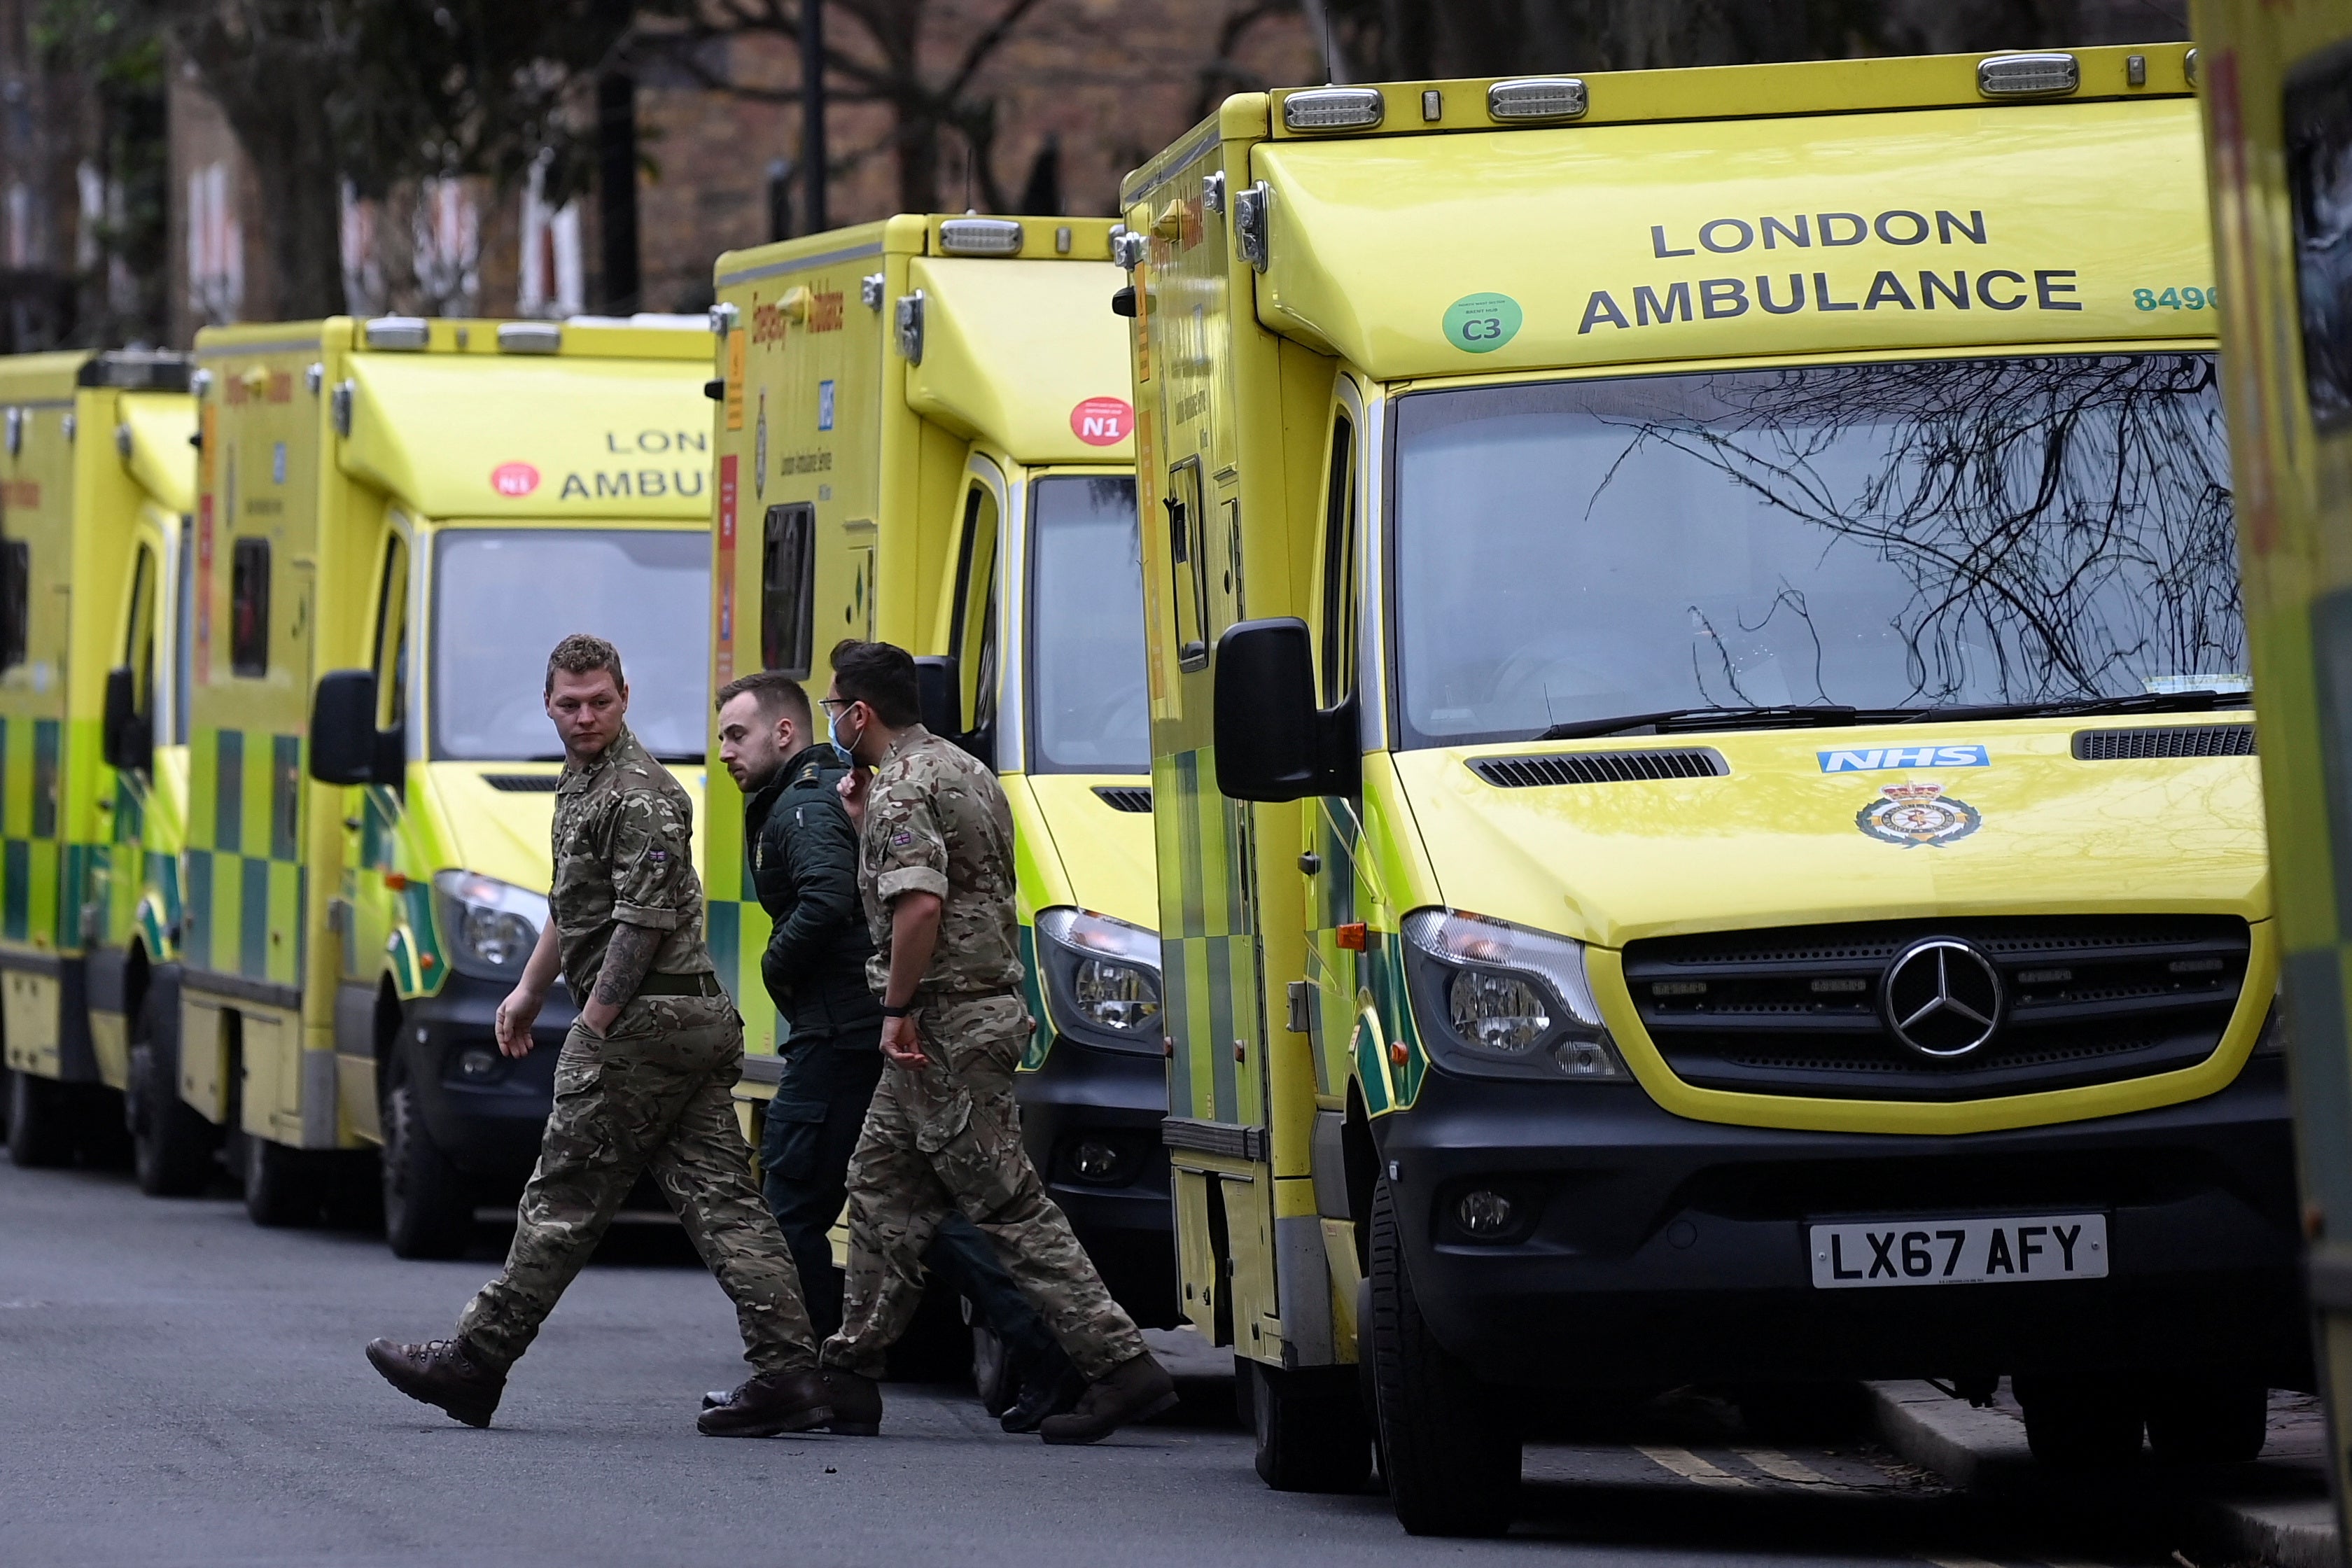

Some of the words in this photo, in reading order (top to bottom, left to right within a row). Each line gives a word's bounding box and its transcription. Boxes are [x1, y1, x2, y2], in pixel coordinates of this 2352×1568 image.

[1651, 210, 1987, 259] LONDON
[1577, 270, 2083, 335] AMBULANCE
[1462, 318, 1502, 341] C3
[1082, 416, 1120, 438] N1
[606, 430, 707, 454] LON
[560, 470, 713, 500] AMBU
[1826, 746, 1978, 771] NHS
[1830, 1229, 1966, 1280] LX67
[1986, 1224, 2081, 1275] AFY
